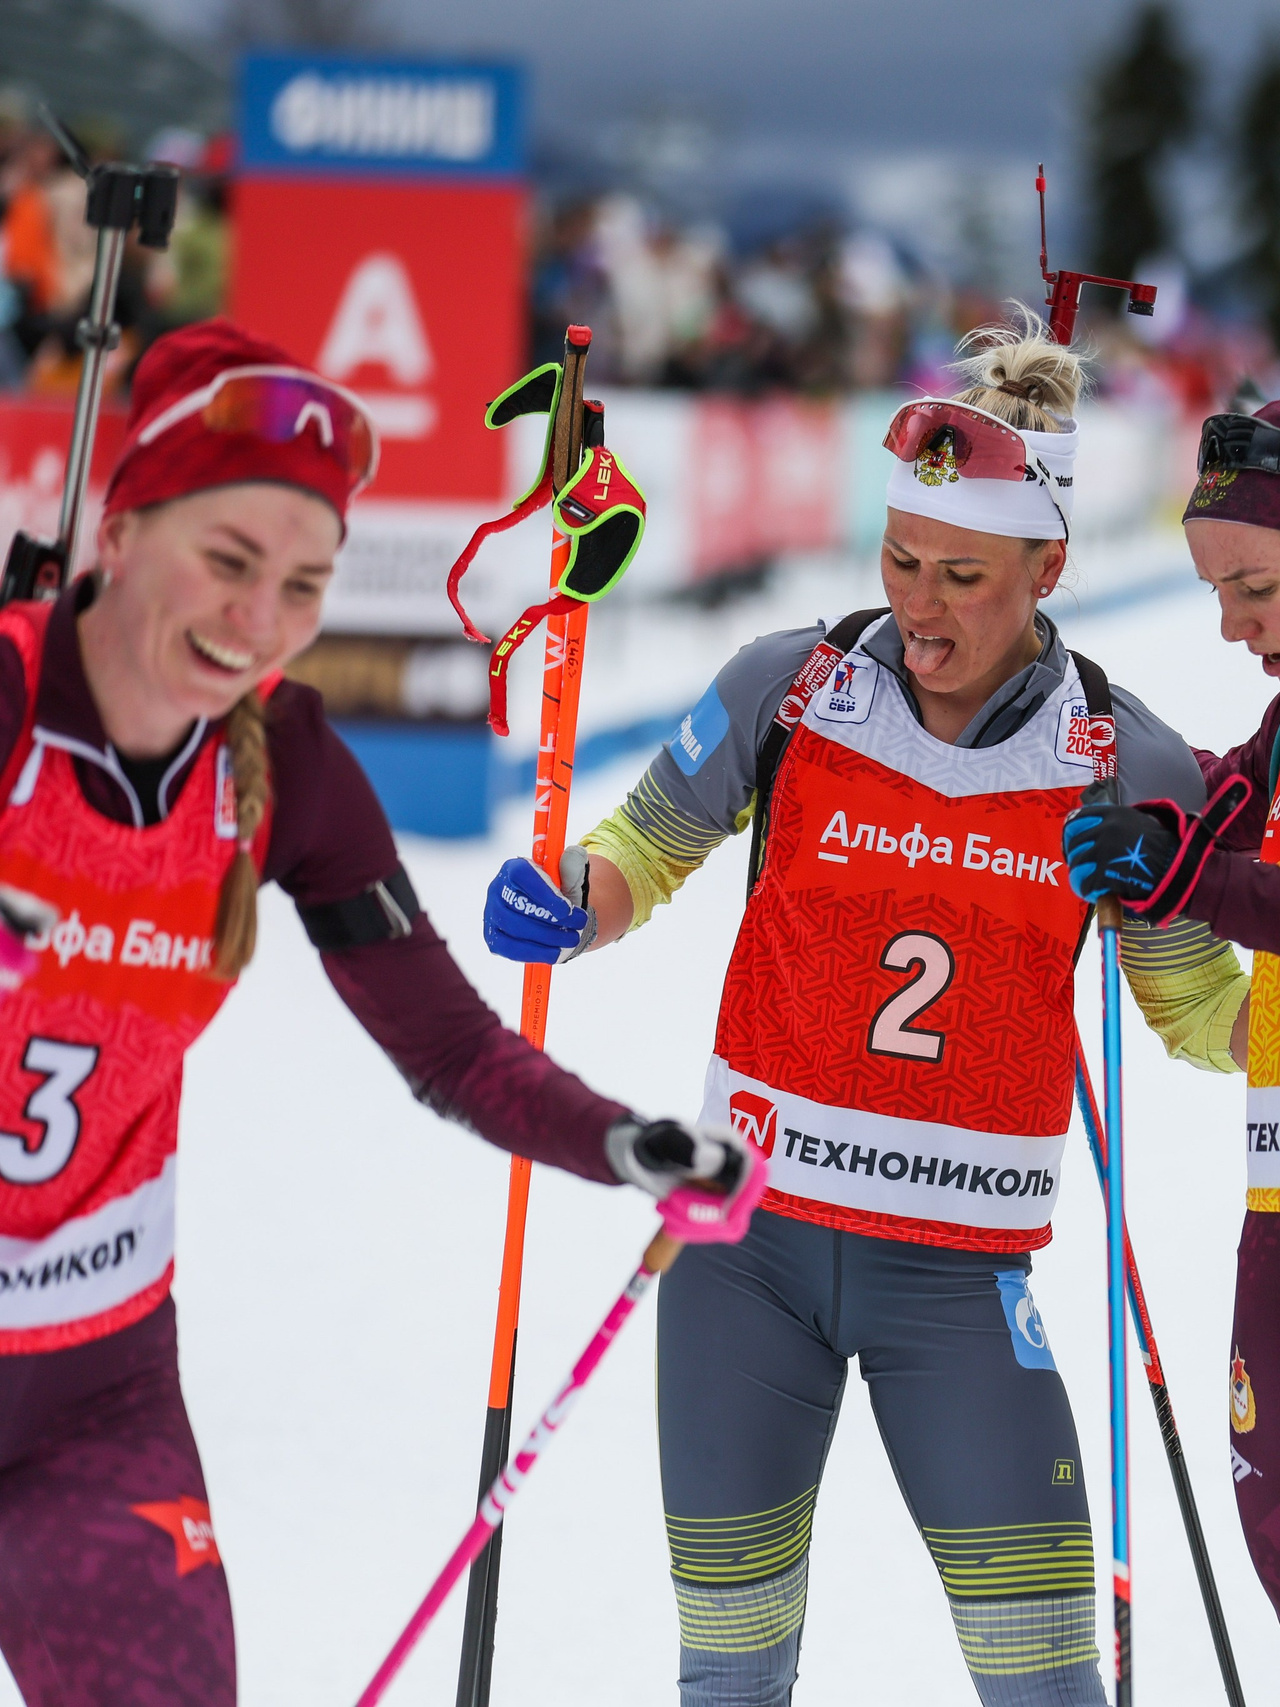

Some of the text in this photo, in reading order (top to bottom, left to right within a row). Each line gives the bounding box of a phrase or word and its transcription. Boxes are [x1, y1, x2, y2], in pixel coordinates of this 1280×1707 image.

[491, 619, 532, 678] LEKI
[792, 649, 823, 688] Клиника
[805, 653, 828, 686] доктора
[829, 702, 856, 713] СБР
[818, 810, 1064, 887] Альфа Банк
[866, 930, 956, 1064] 2
[0, 1036, 101, 1185] 3
[783, 1128, 1054, 1198] ТЕХНОНИКОЛЬ
